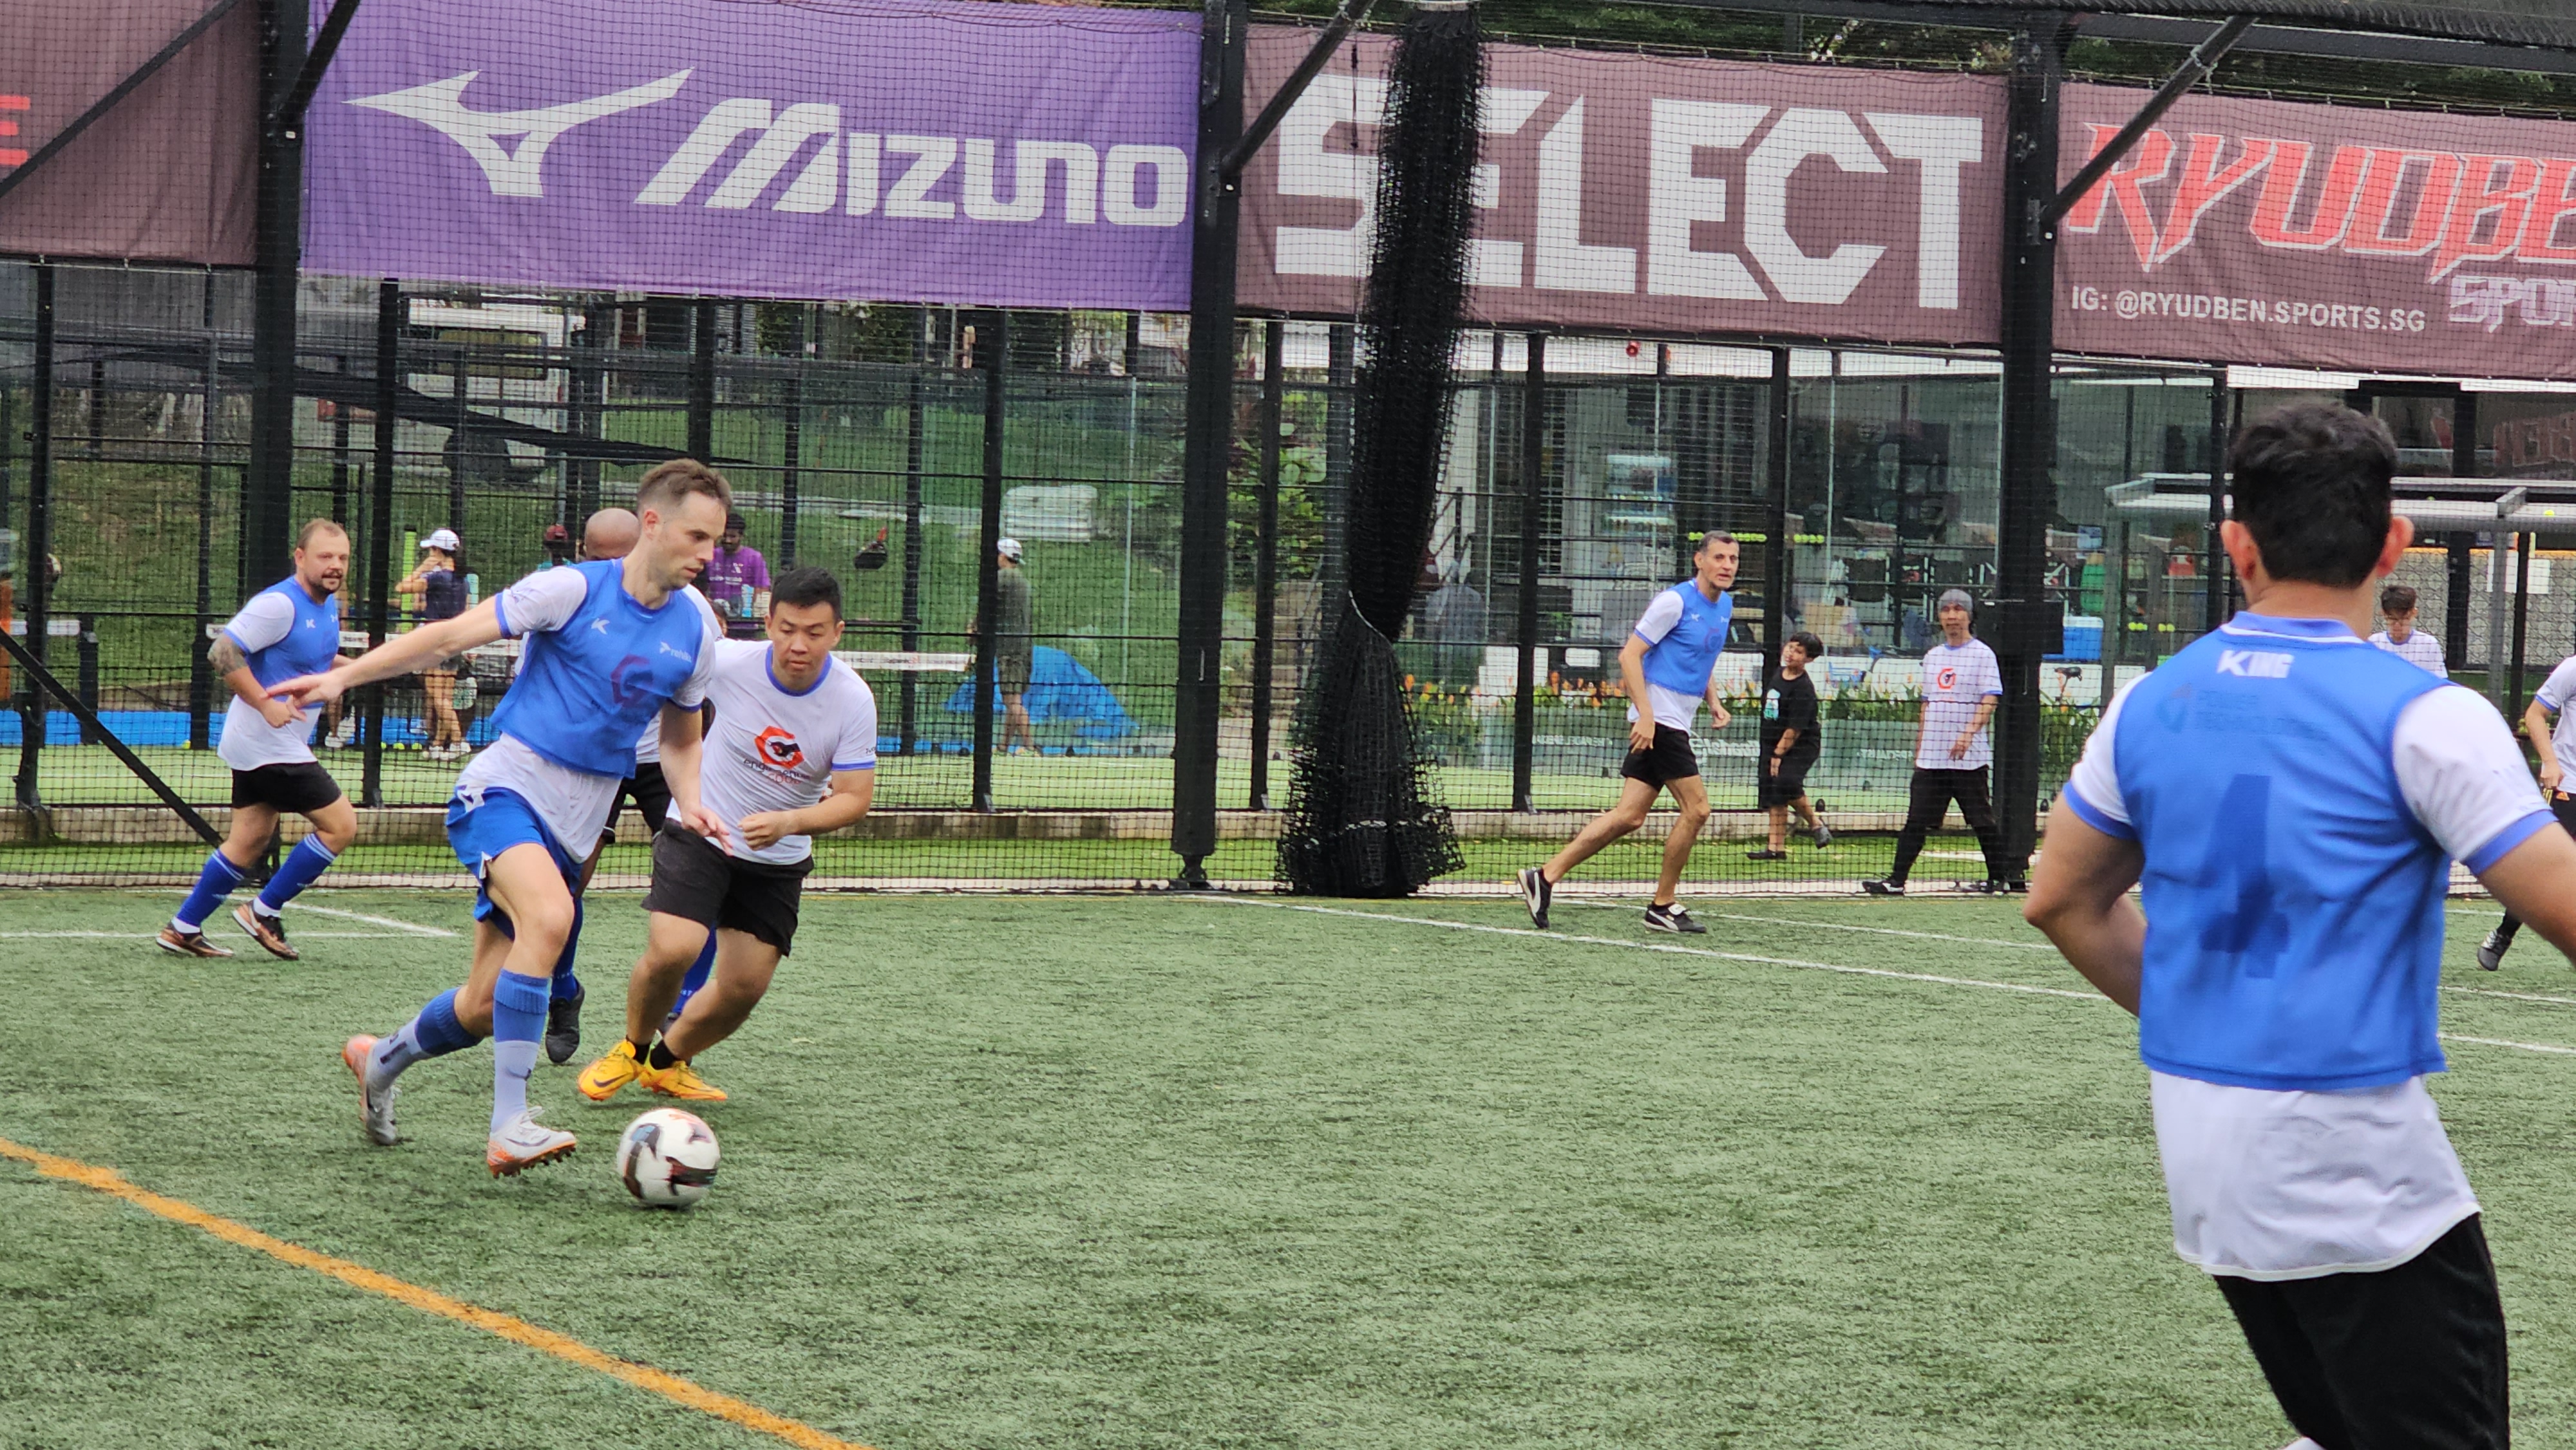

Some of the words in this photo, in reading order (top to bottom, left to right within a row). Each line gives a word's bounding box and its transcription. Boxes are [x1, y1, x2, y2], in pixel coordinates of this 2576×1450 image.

[1276, 73, 1982, 309] SELECT
[2071, 286, 2107, 311] IG:
[2115, 290, 2426, 332] @RYUDBEN.SPORTS.SG
